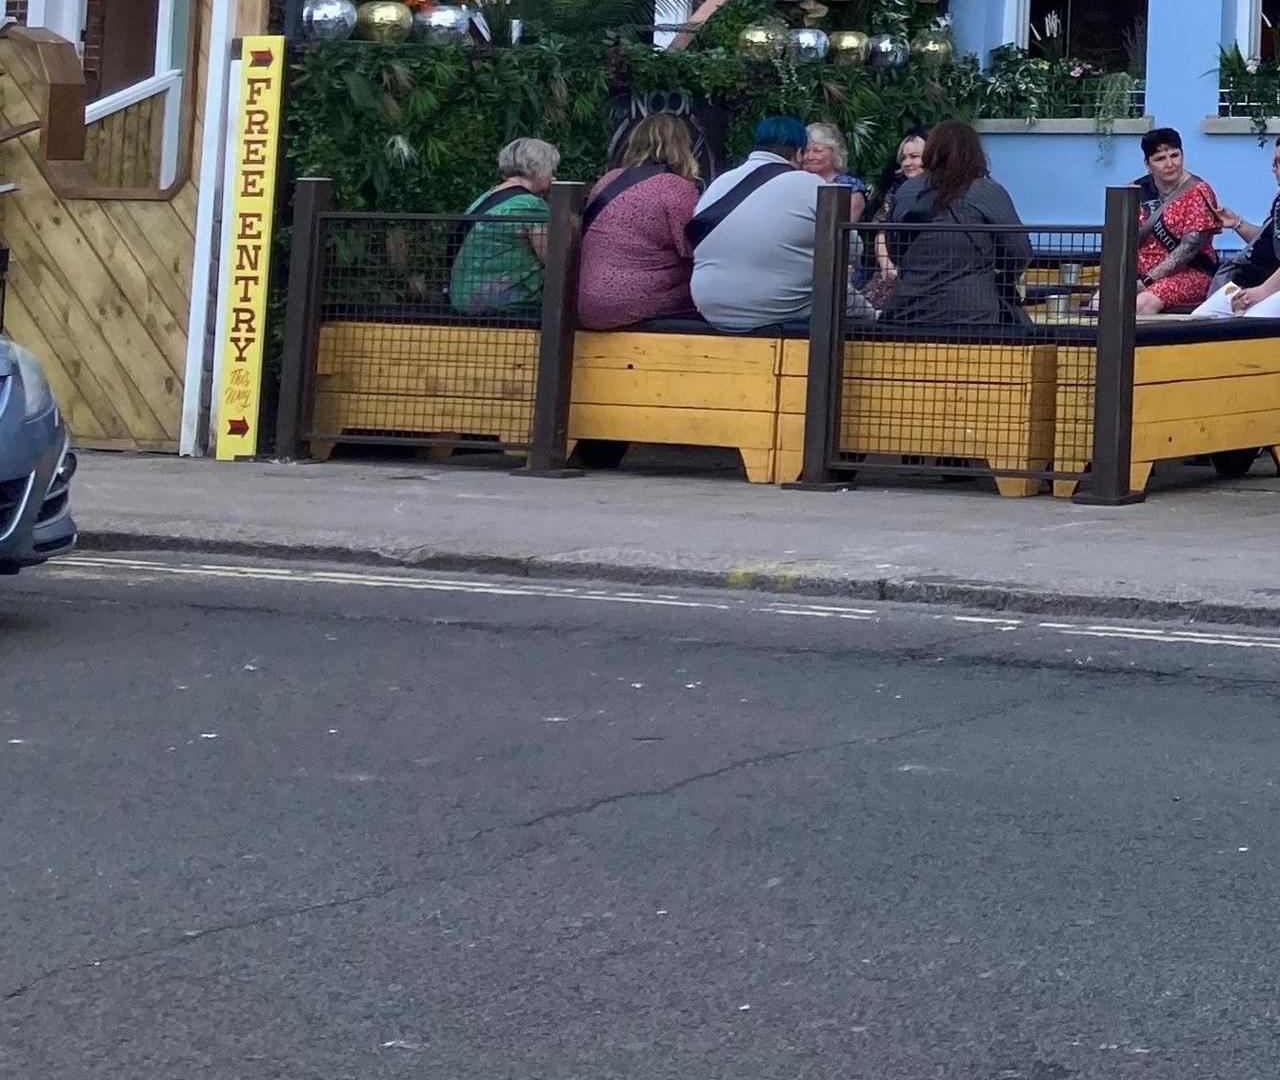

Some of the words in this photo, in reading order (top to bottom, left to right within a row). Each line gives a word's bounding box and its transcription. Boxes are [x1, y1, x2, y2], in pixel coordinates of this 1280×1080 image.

[241, 78, 271, 197] FREE
[230, 212, 262, 362] ENTRY
[225, 388, 252, 411] Way
